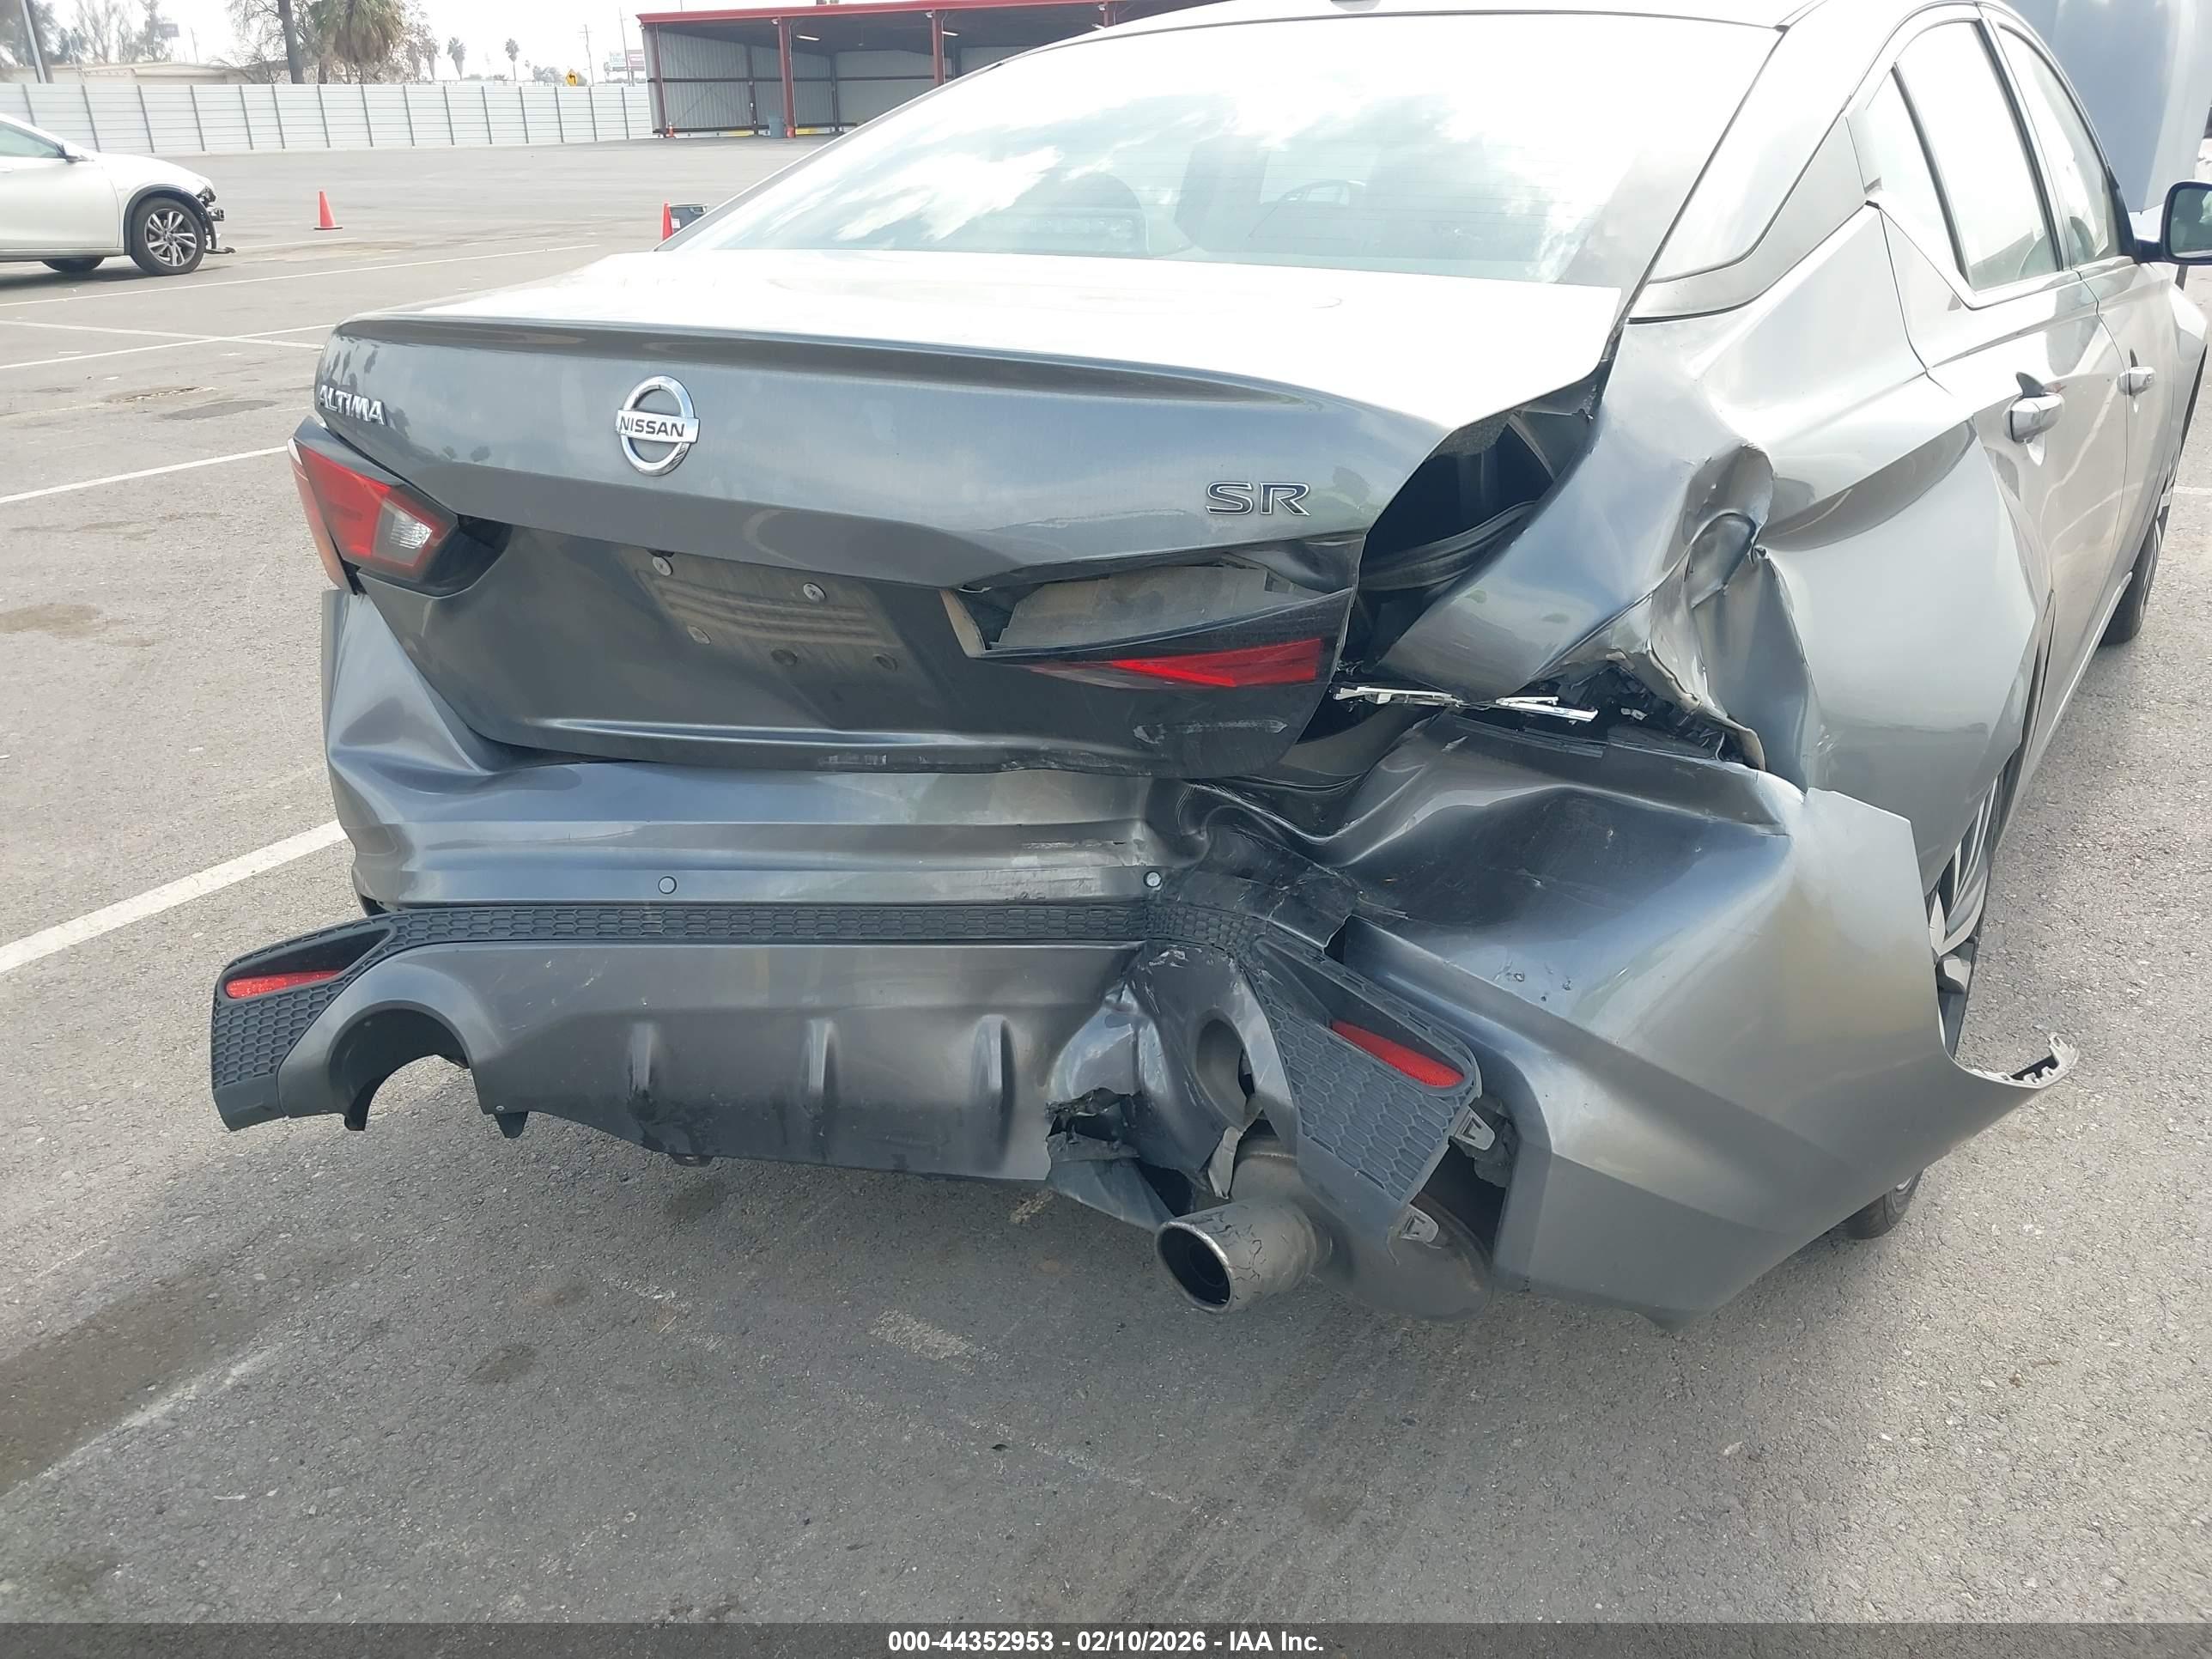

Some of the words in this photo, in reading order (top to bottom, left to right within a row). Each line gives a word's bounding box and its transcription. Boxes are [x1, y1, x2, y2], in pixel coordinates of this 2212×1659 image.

[319, 385, 385, 425] ALTIMA
[619, 416, 685, 437] NISSAN
[1206, 482, 1311, 516] SR
